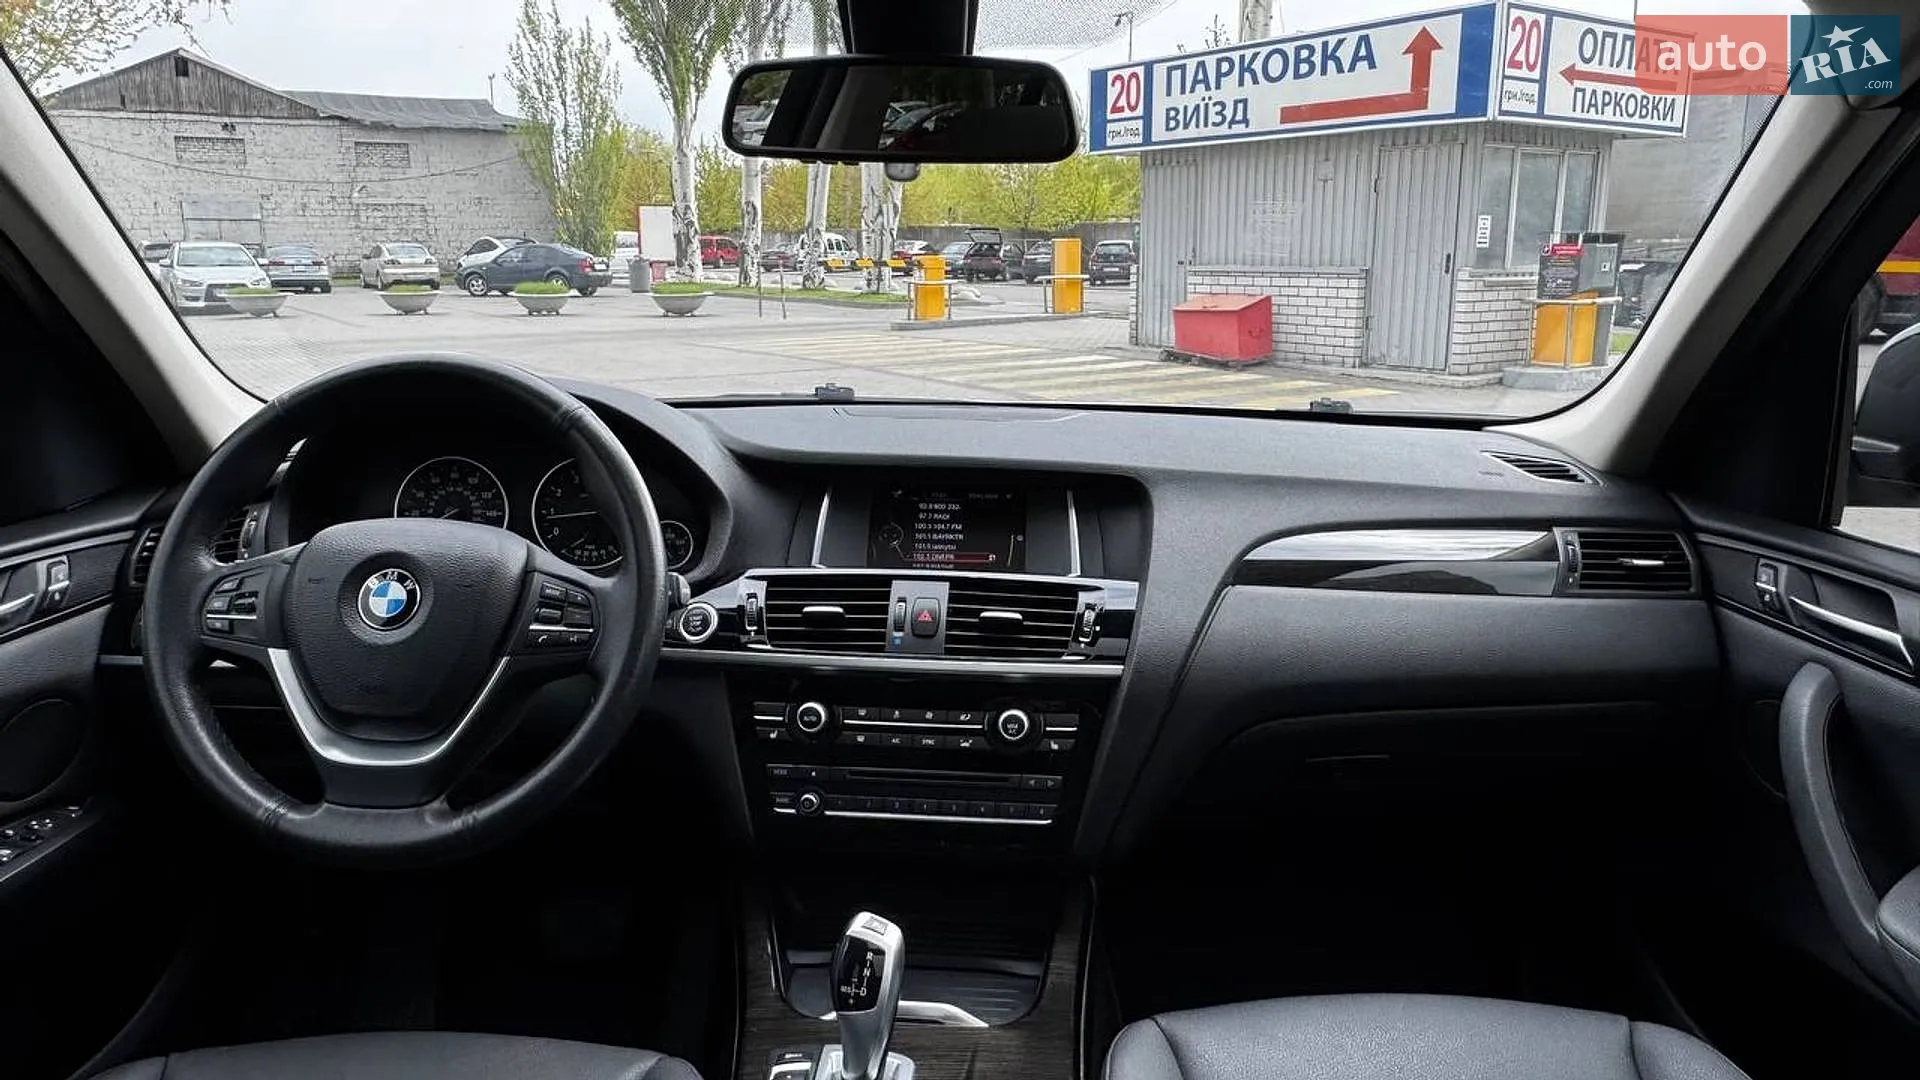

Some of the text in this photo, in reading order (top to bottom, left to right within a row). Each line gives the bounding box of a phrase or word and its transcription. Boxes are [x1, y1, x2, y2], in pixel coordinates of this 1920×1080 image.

[1507, 16, 1543, 73] 20
[1165, 34, 1378, 97] ПАРКОВКА
[1109, 71, 1141, 114] 20
[1572, 87, 1676, 122] ПАРКОВКИ
[1164, 97, 1249, 132] ВИЇЗД
[367, 571, 416, 590] BMW
